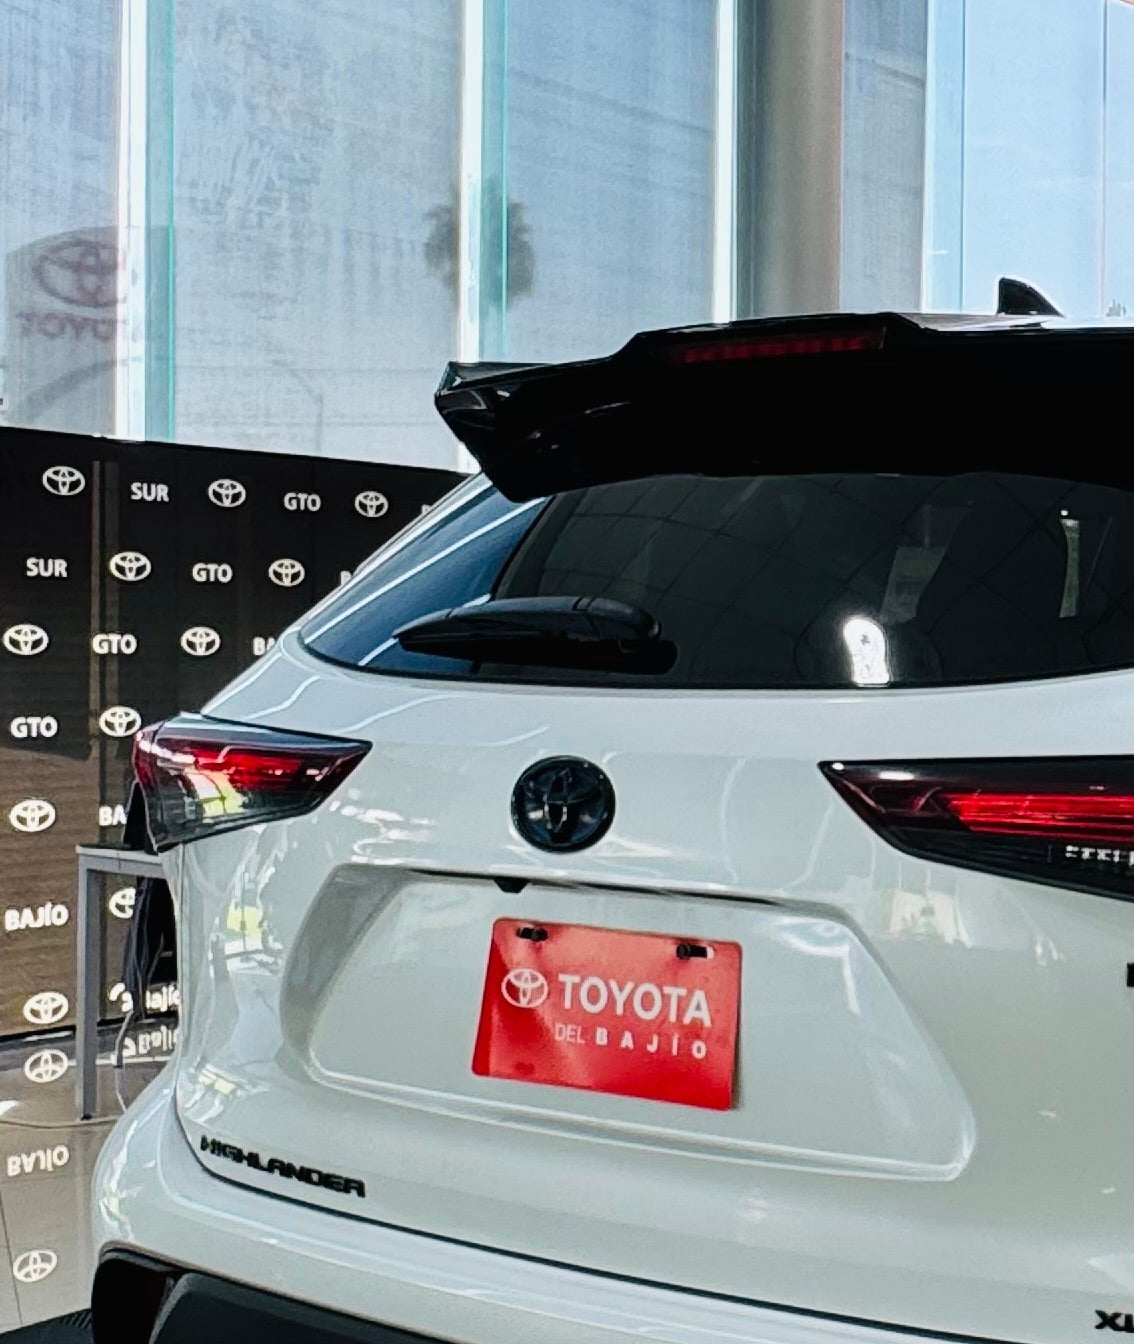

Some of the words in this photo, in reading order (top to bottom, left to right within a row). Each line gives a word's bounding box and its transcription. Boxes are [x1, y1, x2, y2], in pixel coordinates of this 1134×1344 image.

[131, 482, 169, 502] SUR
[284, 493, 321, 511] GTO
[26, 557, 68, 578] SUR
[192, 562, 233, 583] GTO
[92, 633, 137, 655] GTO
[10, 716, 58, 739] GTO
[558, 973, 712, 1028] TOYOTA
[555, 1024, 585, 1044] DEL
[200, 1135, 366, 1198] HIGHLANDER
